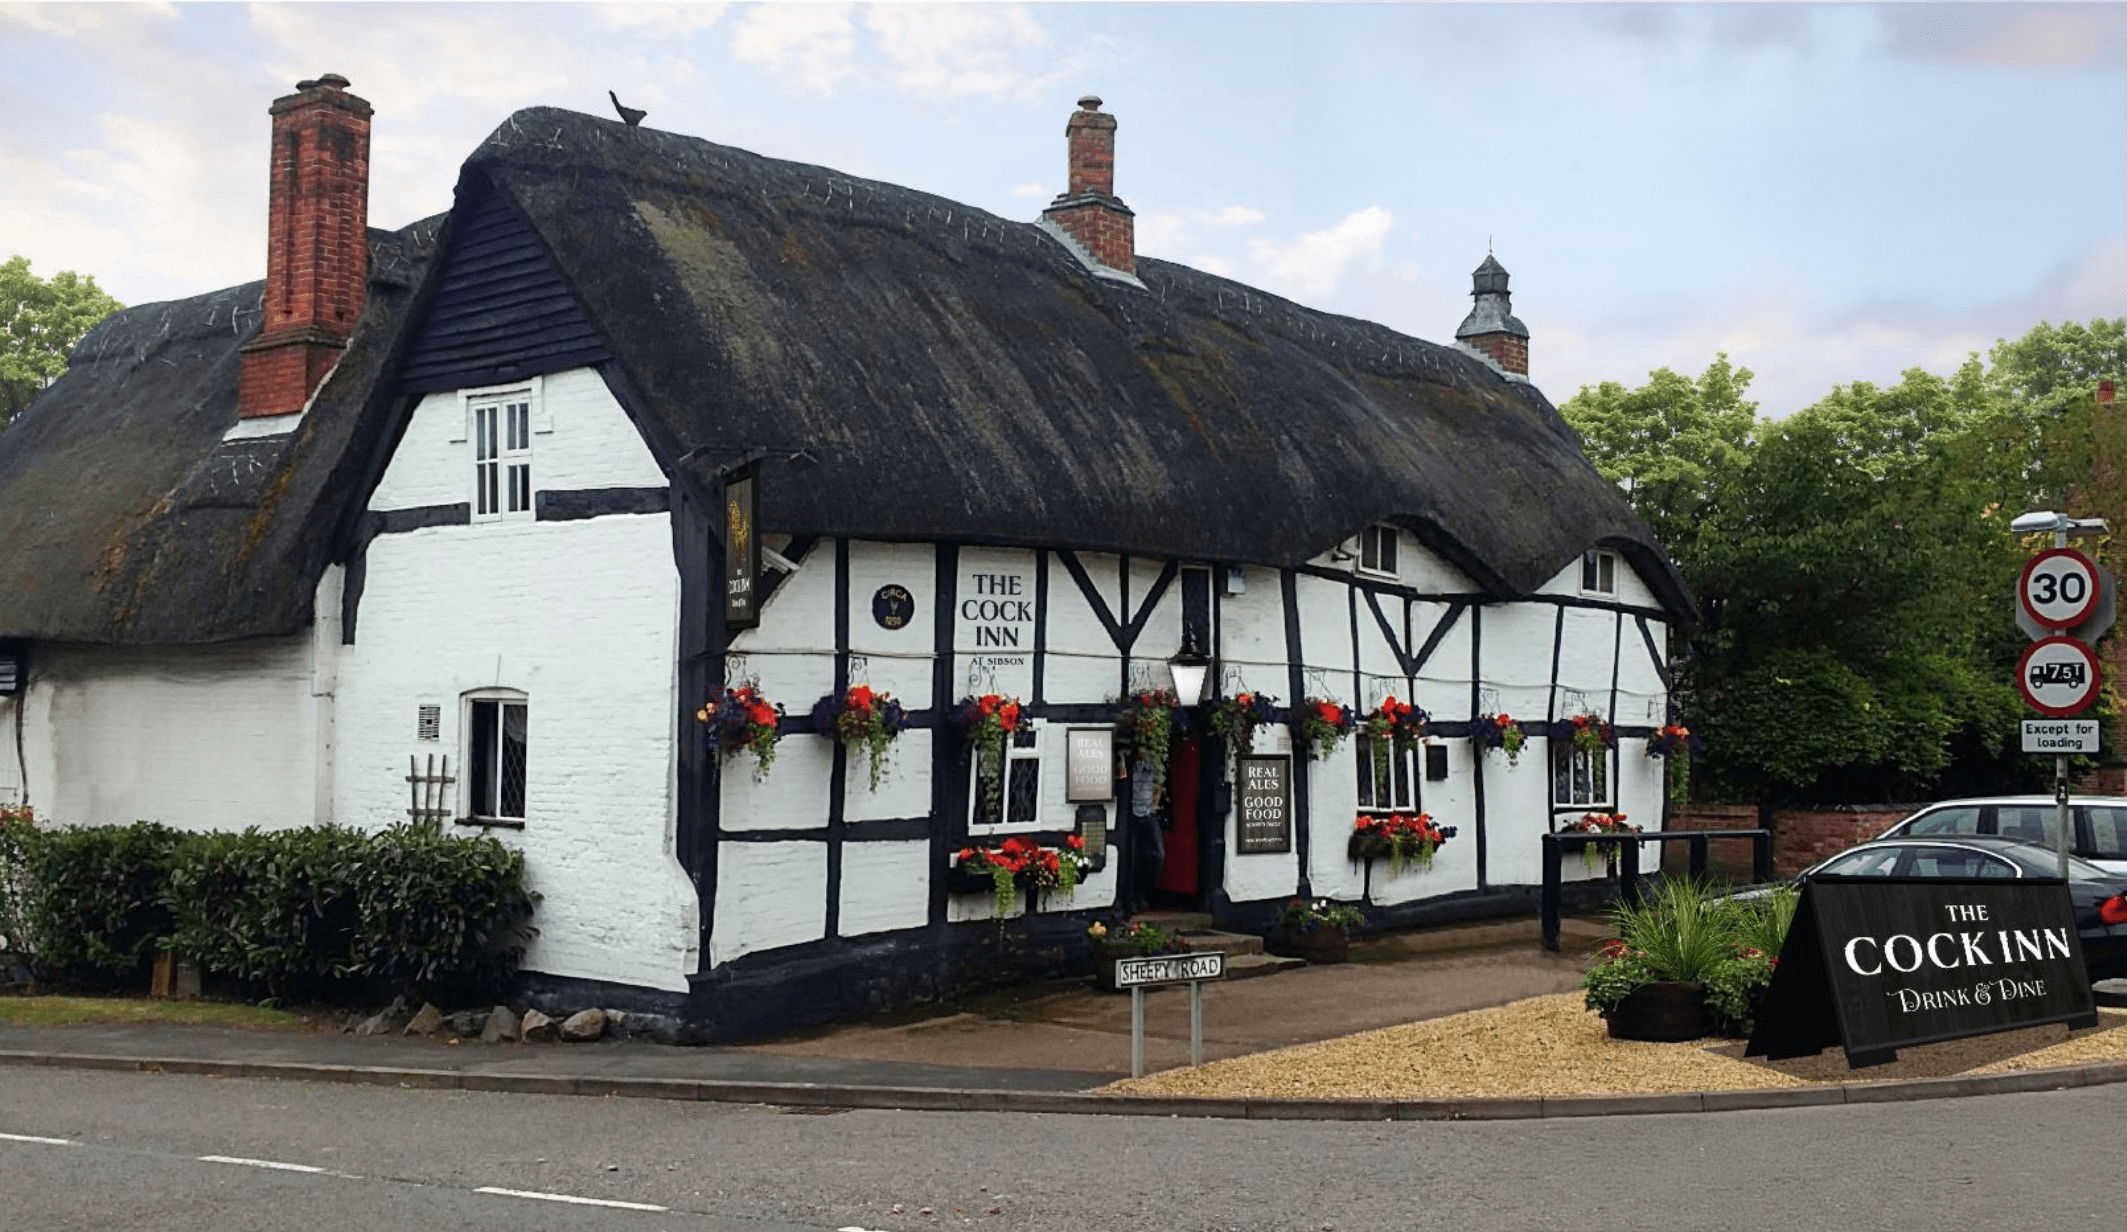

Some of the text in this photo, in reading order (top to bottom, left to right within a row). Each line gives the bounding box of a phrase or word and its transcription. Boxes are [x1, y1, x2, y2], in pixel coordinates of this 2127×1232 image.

[972, 574, 1022, 595] THE
[2033, 572, 2086, 604] 30
[961, 599, 1033, 621] COCK
[976, 626, 1019, 647] INN
[971, 657, 1025, 666] AT SIBSON
[2025, 723, 2094, 736] Except for
[2037, 737, 2083, 750] loading
[1248, 766, 1279, 778] REAL
[1247, 778, 1279, 790] ALES
[1244, 796, 1283, 808] GOOD
[1245, 808, 1282, 820] FOOD
[1945, 904, 1989, 922] THE
[1844, 927, 2071, 976] COCK INN
[1121, 959, 1218, 980] SHEEPY ROAD
[1975, 982, 1992, 1005] &
